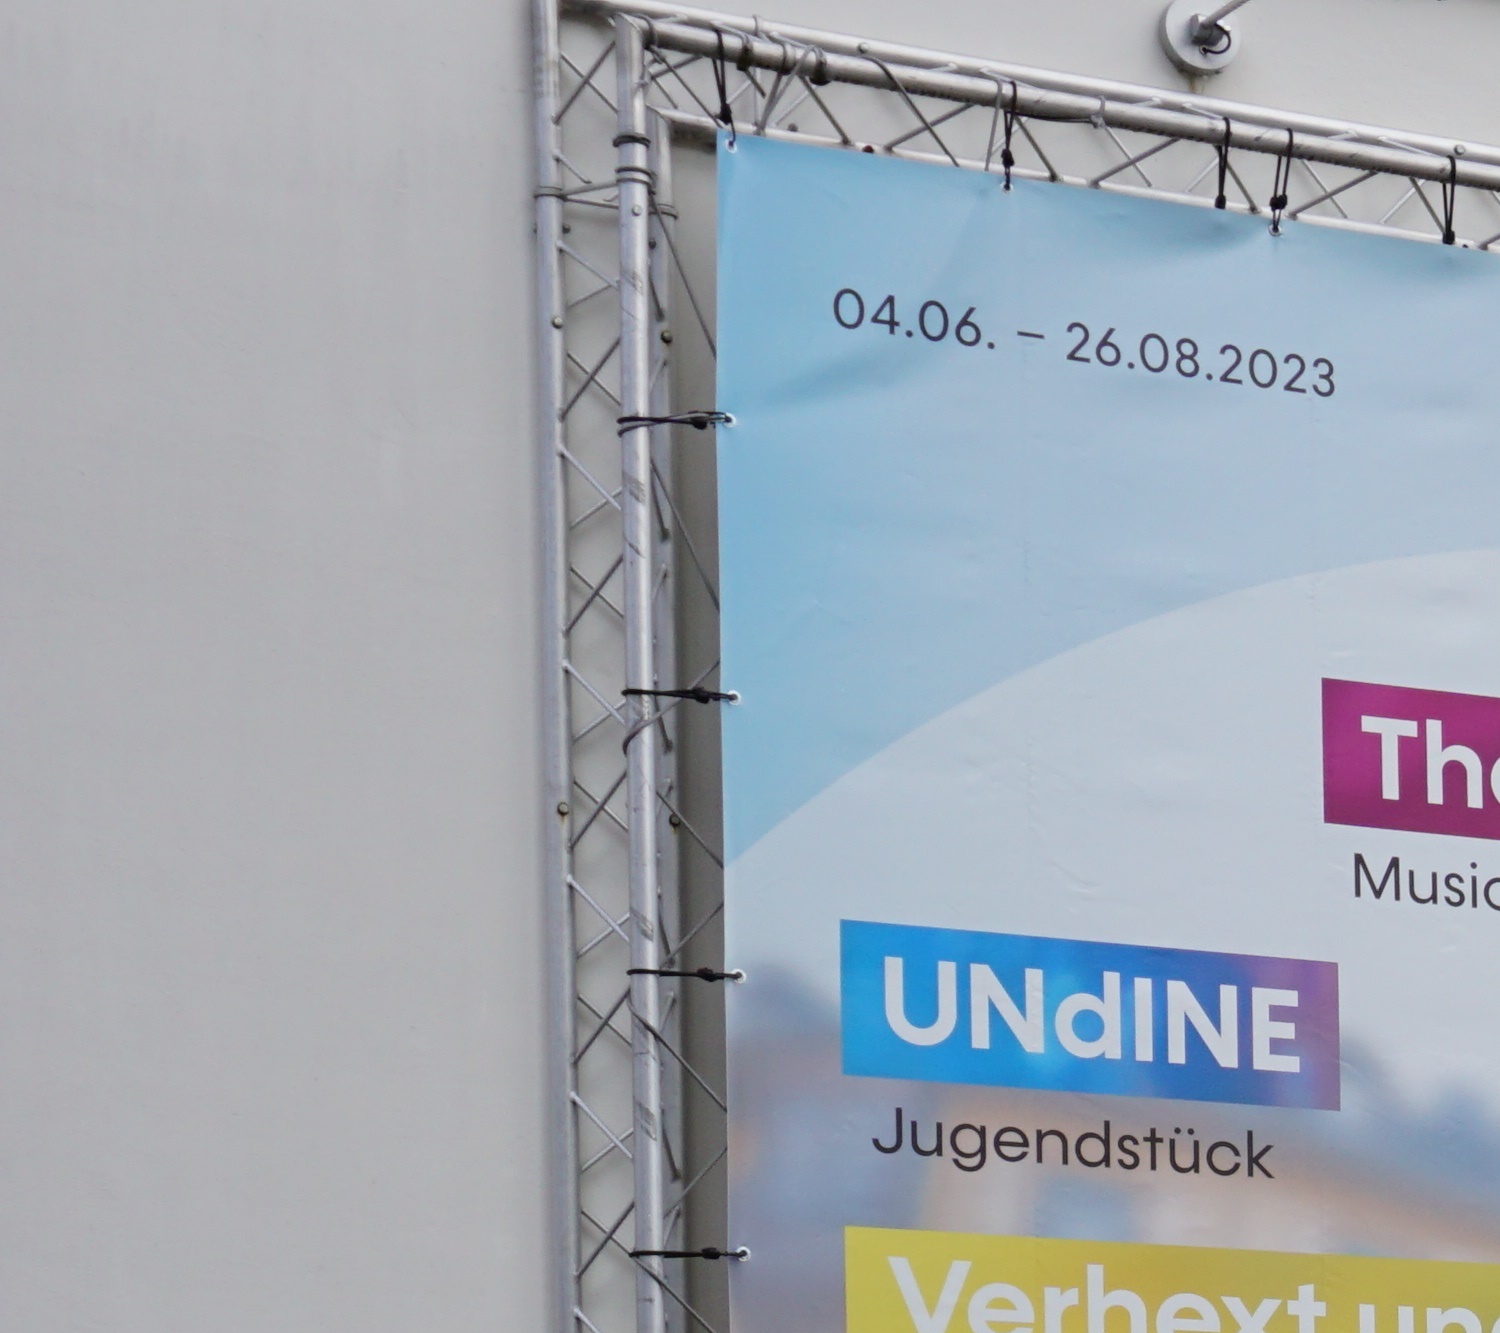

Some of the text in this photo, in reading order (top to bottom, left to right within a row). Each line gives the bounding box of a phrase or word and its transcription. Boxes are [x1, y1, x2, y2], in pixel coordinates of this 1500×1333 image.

[833, 287, 997, 351] 04.06.
[1067, 322, 1334, 397] 26.08.2023
[885, 955, 1301, 1073] UNdINE
[872, 1108, 1274, 1178] Jugendstück
